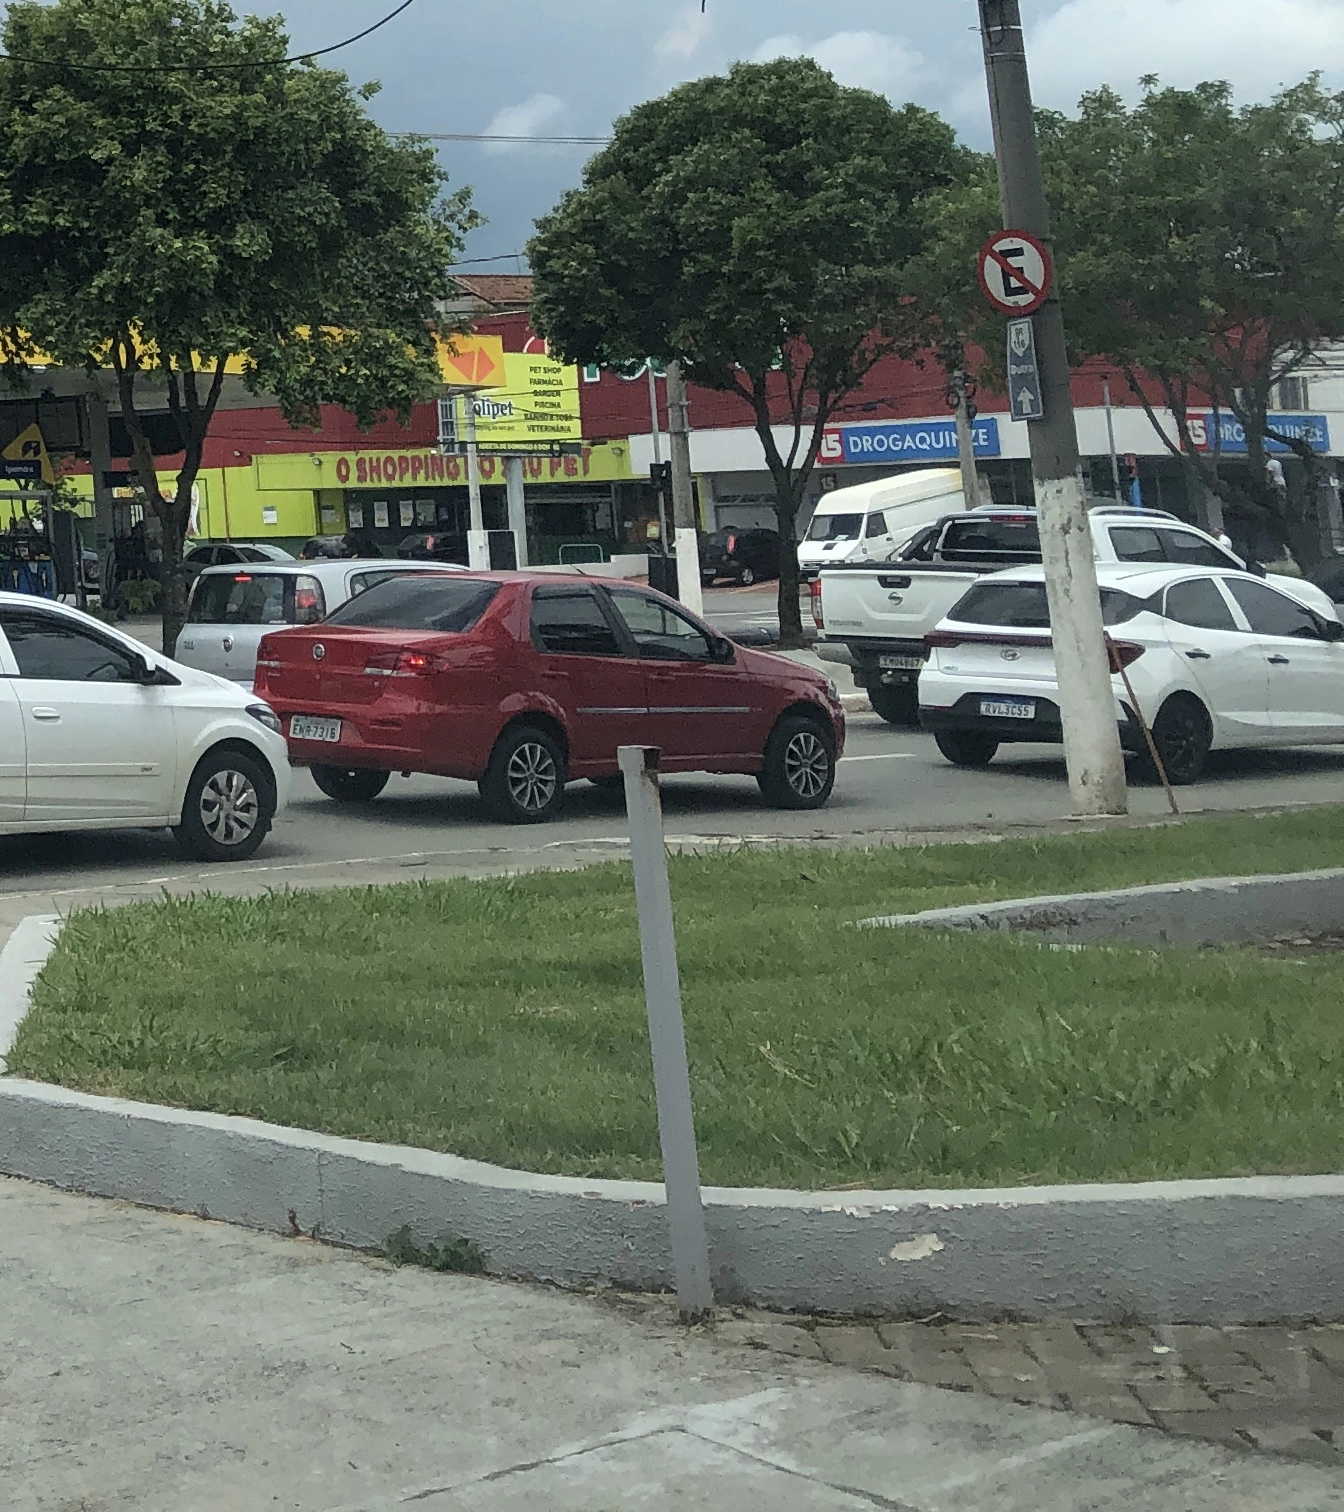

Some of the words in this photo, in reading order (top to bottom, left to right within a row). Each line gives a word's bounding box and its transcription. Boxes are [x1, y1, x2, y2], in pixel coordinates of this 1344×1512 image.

[999, 247, 1030, 297] E
[336, 457, 350, 483] O
[356, 455, 461, 483] SHOPPING
[549, 449, 592, 478] PET
